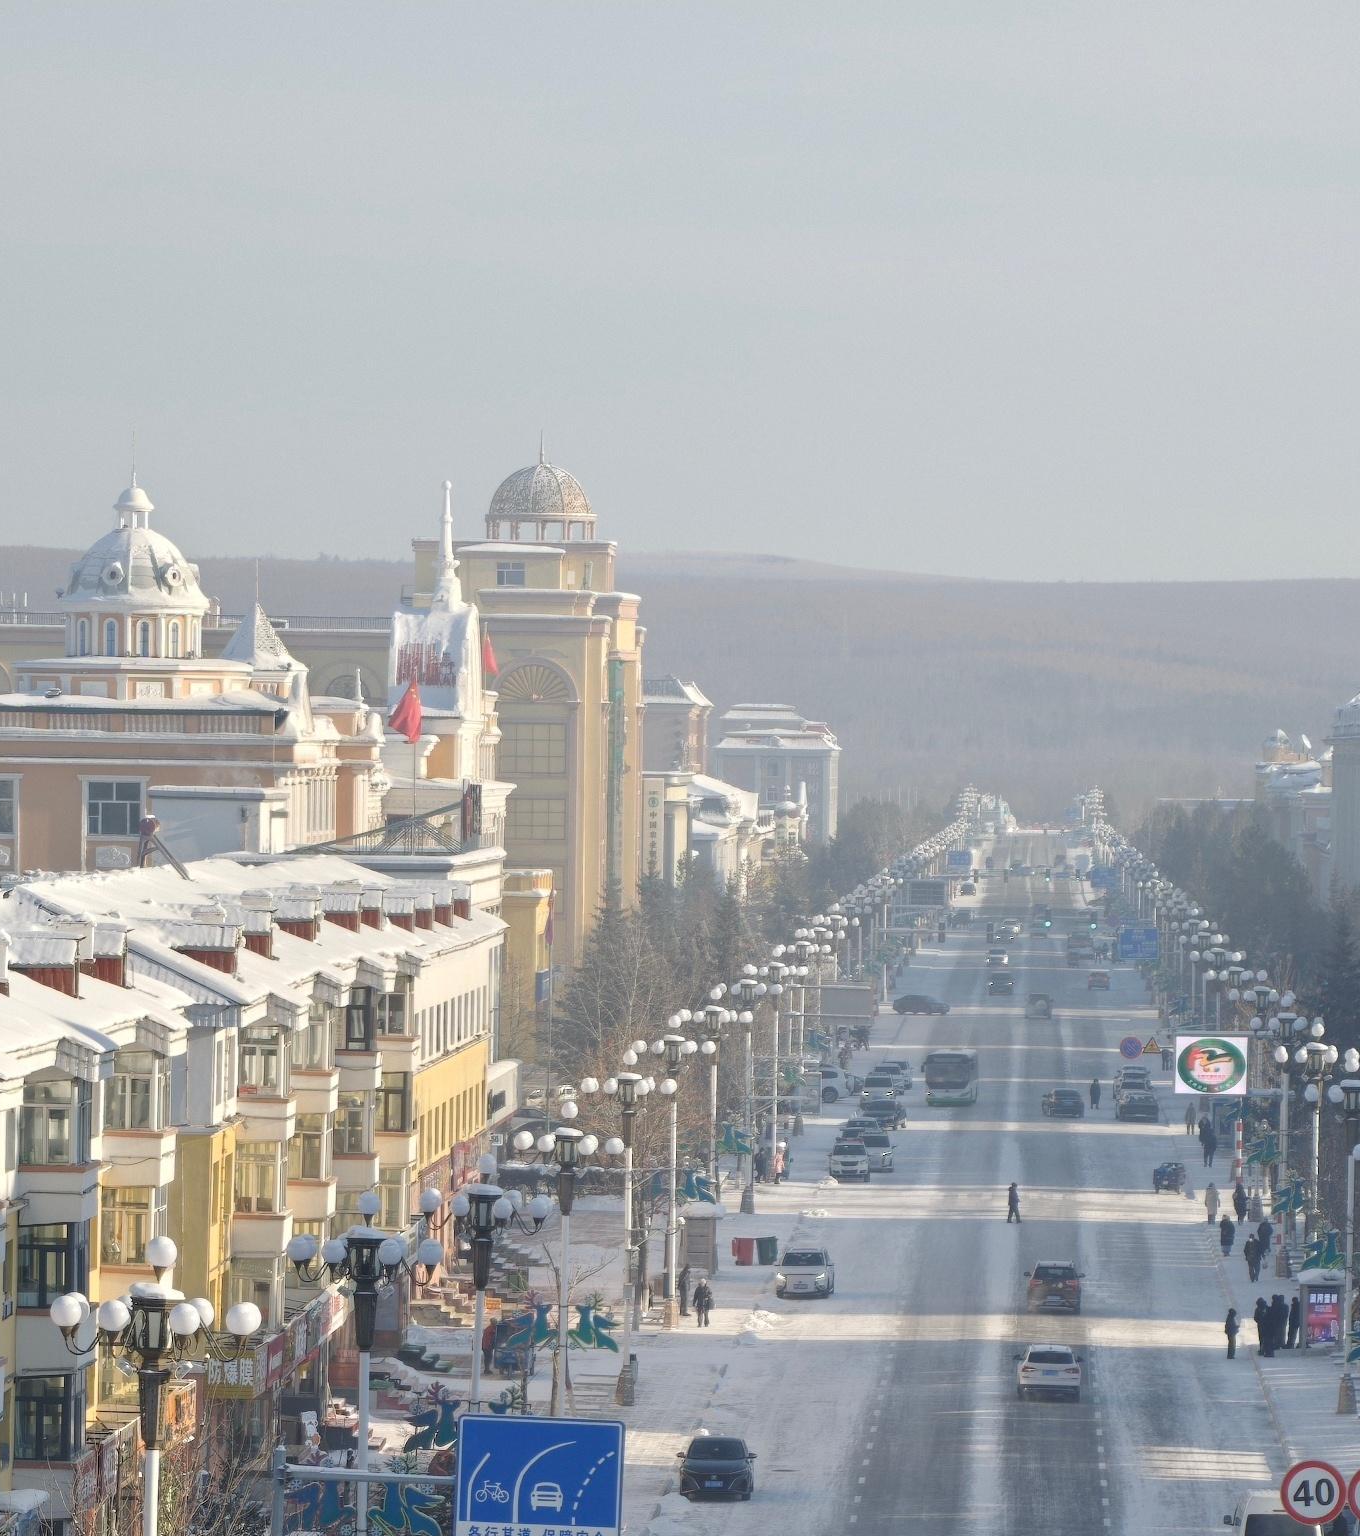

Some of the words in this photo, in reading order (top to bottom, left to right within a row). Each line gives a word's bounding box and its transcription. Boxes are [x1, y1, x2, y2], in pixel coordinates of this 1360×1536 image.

[207, 1357, 254, 1386] 防爆膜
[1292, 1477, 1335, 1507] 40
